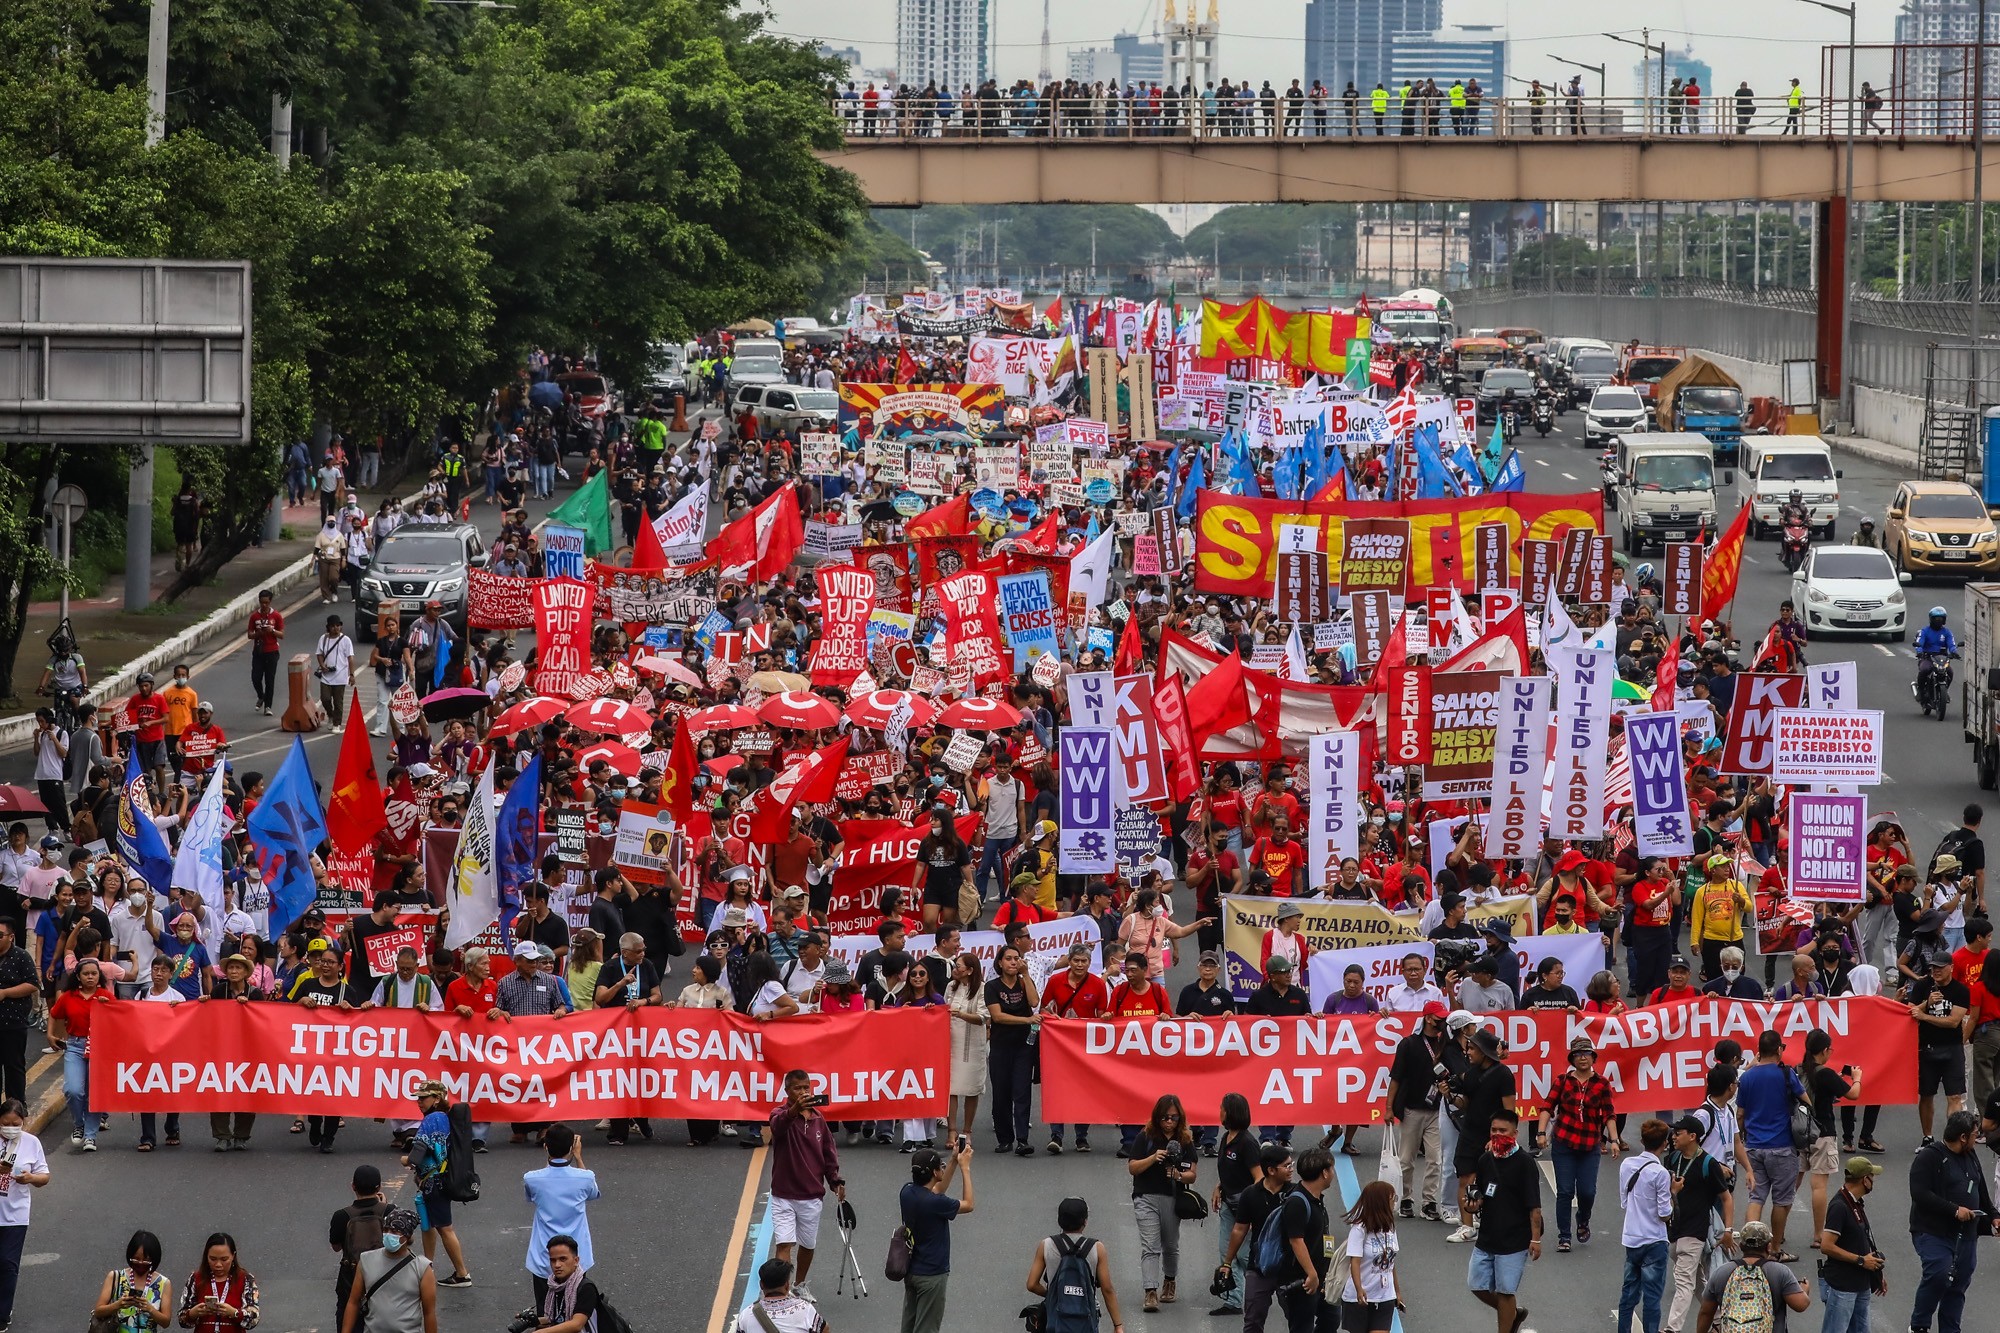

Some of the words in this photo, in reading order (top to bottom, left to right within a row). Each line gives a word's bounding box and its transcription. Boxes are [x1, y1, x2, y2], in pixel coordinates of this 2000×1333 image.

[1200, 296, 1371, 374] KMU
[1005, 339, 1060, 365] SAVE
[1005, 363, 1025, 374] RICE
[1183, 373, 1217, 381] MATERNITY
[1183, 380, 1213, 388] BENEFITS
[1138, 365, 1146, 438] BUKLURAN
[912, 453, 941, 462] DEFEND
[1032, 444, 1055, 452] LOKAL
[1057, 444, 1067, 452] NA
[1032, 452, 1071, 461] PRODUKSYON
[1048, 462, 1067, 470] HINDI
[1084, 460, 1109, 470] JUNK
[1670, 503, 1680, 512] 25
[546, 535, 584, 553] MANDATORY
[1161, 510, 1176, 570] SENTRO
[1350, 534, 1405, 547] SAHOD
[1349, 546, 1402, 559] ITAAS!
[1486, 527, 1500, 589] SENTRO
[1564, 531, 1586, 593] SENTRO
[547, 551, 583, 581] ROTC
[1343, 560, 1404, 573] PRESYO
[1532, 542, 1548, 603] SENTRO
[1590, 538, 1604, 602] SENTRO
[469, 569, 526, 589] KABATAAN
[822, 571, 874, 600] UNITED
[942, 574, 987, 602] UNITED
[1288, 555, 1302, 621] SENTRO
[1346, 572, 1399, 586] IBABA!
[1674, 545, 1692, 613] SENTRO
[540, 585, 586, 609] UNITED
[1002, 579, 1047, 601] MENTAL
[623, 602, 668, 622] SERVE
[673, 598, 693, 619] THE
[827, 597, 869, 622] PUP
[1006, 595, 1048, 617] HEALTH
[546, 611, 580, 634] PUP
[830, 623, 857, 639] FOR
[961, 619, 983, 637] FOR
[1009, 611, 1053, 632] CRISIS
[1363, 594, 1382, 662] SENTRO
[553, 634, 571, 645] FOR
[1011, 627, 1053, 645] TUGUNAN
[1315, 633, 1353, 641] KARAPATAN
[819, 638, 868, 657] BUDGET
[543, 645, 580, 672] ACAD
[815, 655, 868, 671] INCREASE
[891, 641, 917, 680] G
[139, 706, 155, 716] PUP
[168, 696, 187, 706] Lee
[1570, 653, 1597, 750] UNITED
[1399, 670, 1420, 760] SENTRO
[1780, 715, 1848, 728] MALAWAK
[1850, 717, 1869, 728] NA
[737, 731, 756, 740] Junk
[757, 731, 771, 739] VFA
[1509, 682, 1536, 775] UNITED
[1780, 728, 1874, 740] KARAPATAN
[1780, 741, 1798, 752] AT
[1801, 741, 1872, 753] SERBISYO
[848, 755, 873, 769] STOP
[875, 753, 888, 765] THE
[1632, 721, 1675, 810] WWU
[1792, 753, 1877, 764] KABABAIHAN!
[1065, 737, 1107, 824] WWU
[1779, 768, 1818, 776] NAGKAISA
[1323, 739, 1344, 833] UNITED
[1566, 755, 1589, 835] LABOR
[557, 814, 585, 825] MARCOS
[1501, 780, 1526, 856] LABOR
[1801, 803, 1855, 826] UNION
[1115, 821, 1146, 830] TRABAHO
[1801, 825, 1854, 837] ORGANIZING
[1266, 851, 1288, 862] BMP
[1801, 838, 1835, 860] NOT
[1836, 844, 1846, 860] a
[1800, 860, 1856, 881] CRIME!
[320, 891, 338, 899] END
[1795, 886, 1821, 894] NAGKAISA
[313, 900, 344, 908] CAMPUS
[1305, 916, 1394, 938] TRABAHO,
[367, 931, 417, 951] DEFEND
[308, 992, 334, 1003] NEVER
[1085, 1018, 1281, 1057] DAGDAG
[1296, 1018, 1363, 1056] NA
[1565, 1000, 1849, 1050] KABUHAYAN
[290, 1023, 420, 1059] ITIGIL
[430, 1030, 508, 1065] ANG
[518, 1026, 764, 1067] KARAHASAN!
[116, 1061, 361, 1098] KAPAKANAN
[373, 1067, 428, 1101] NG
[440, 1070, 558, 1109] MASA,
[568, 1067, 679, 1101] HINDI
[1259, 1067, 1323, 1106] AT
[1064, 1285, 1085, 1297] PRESS
